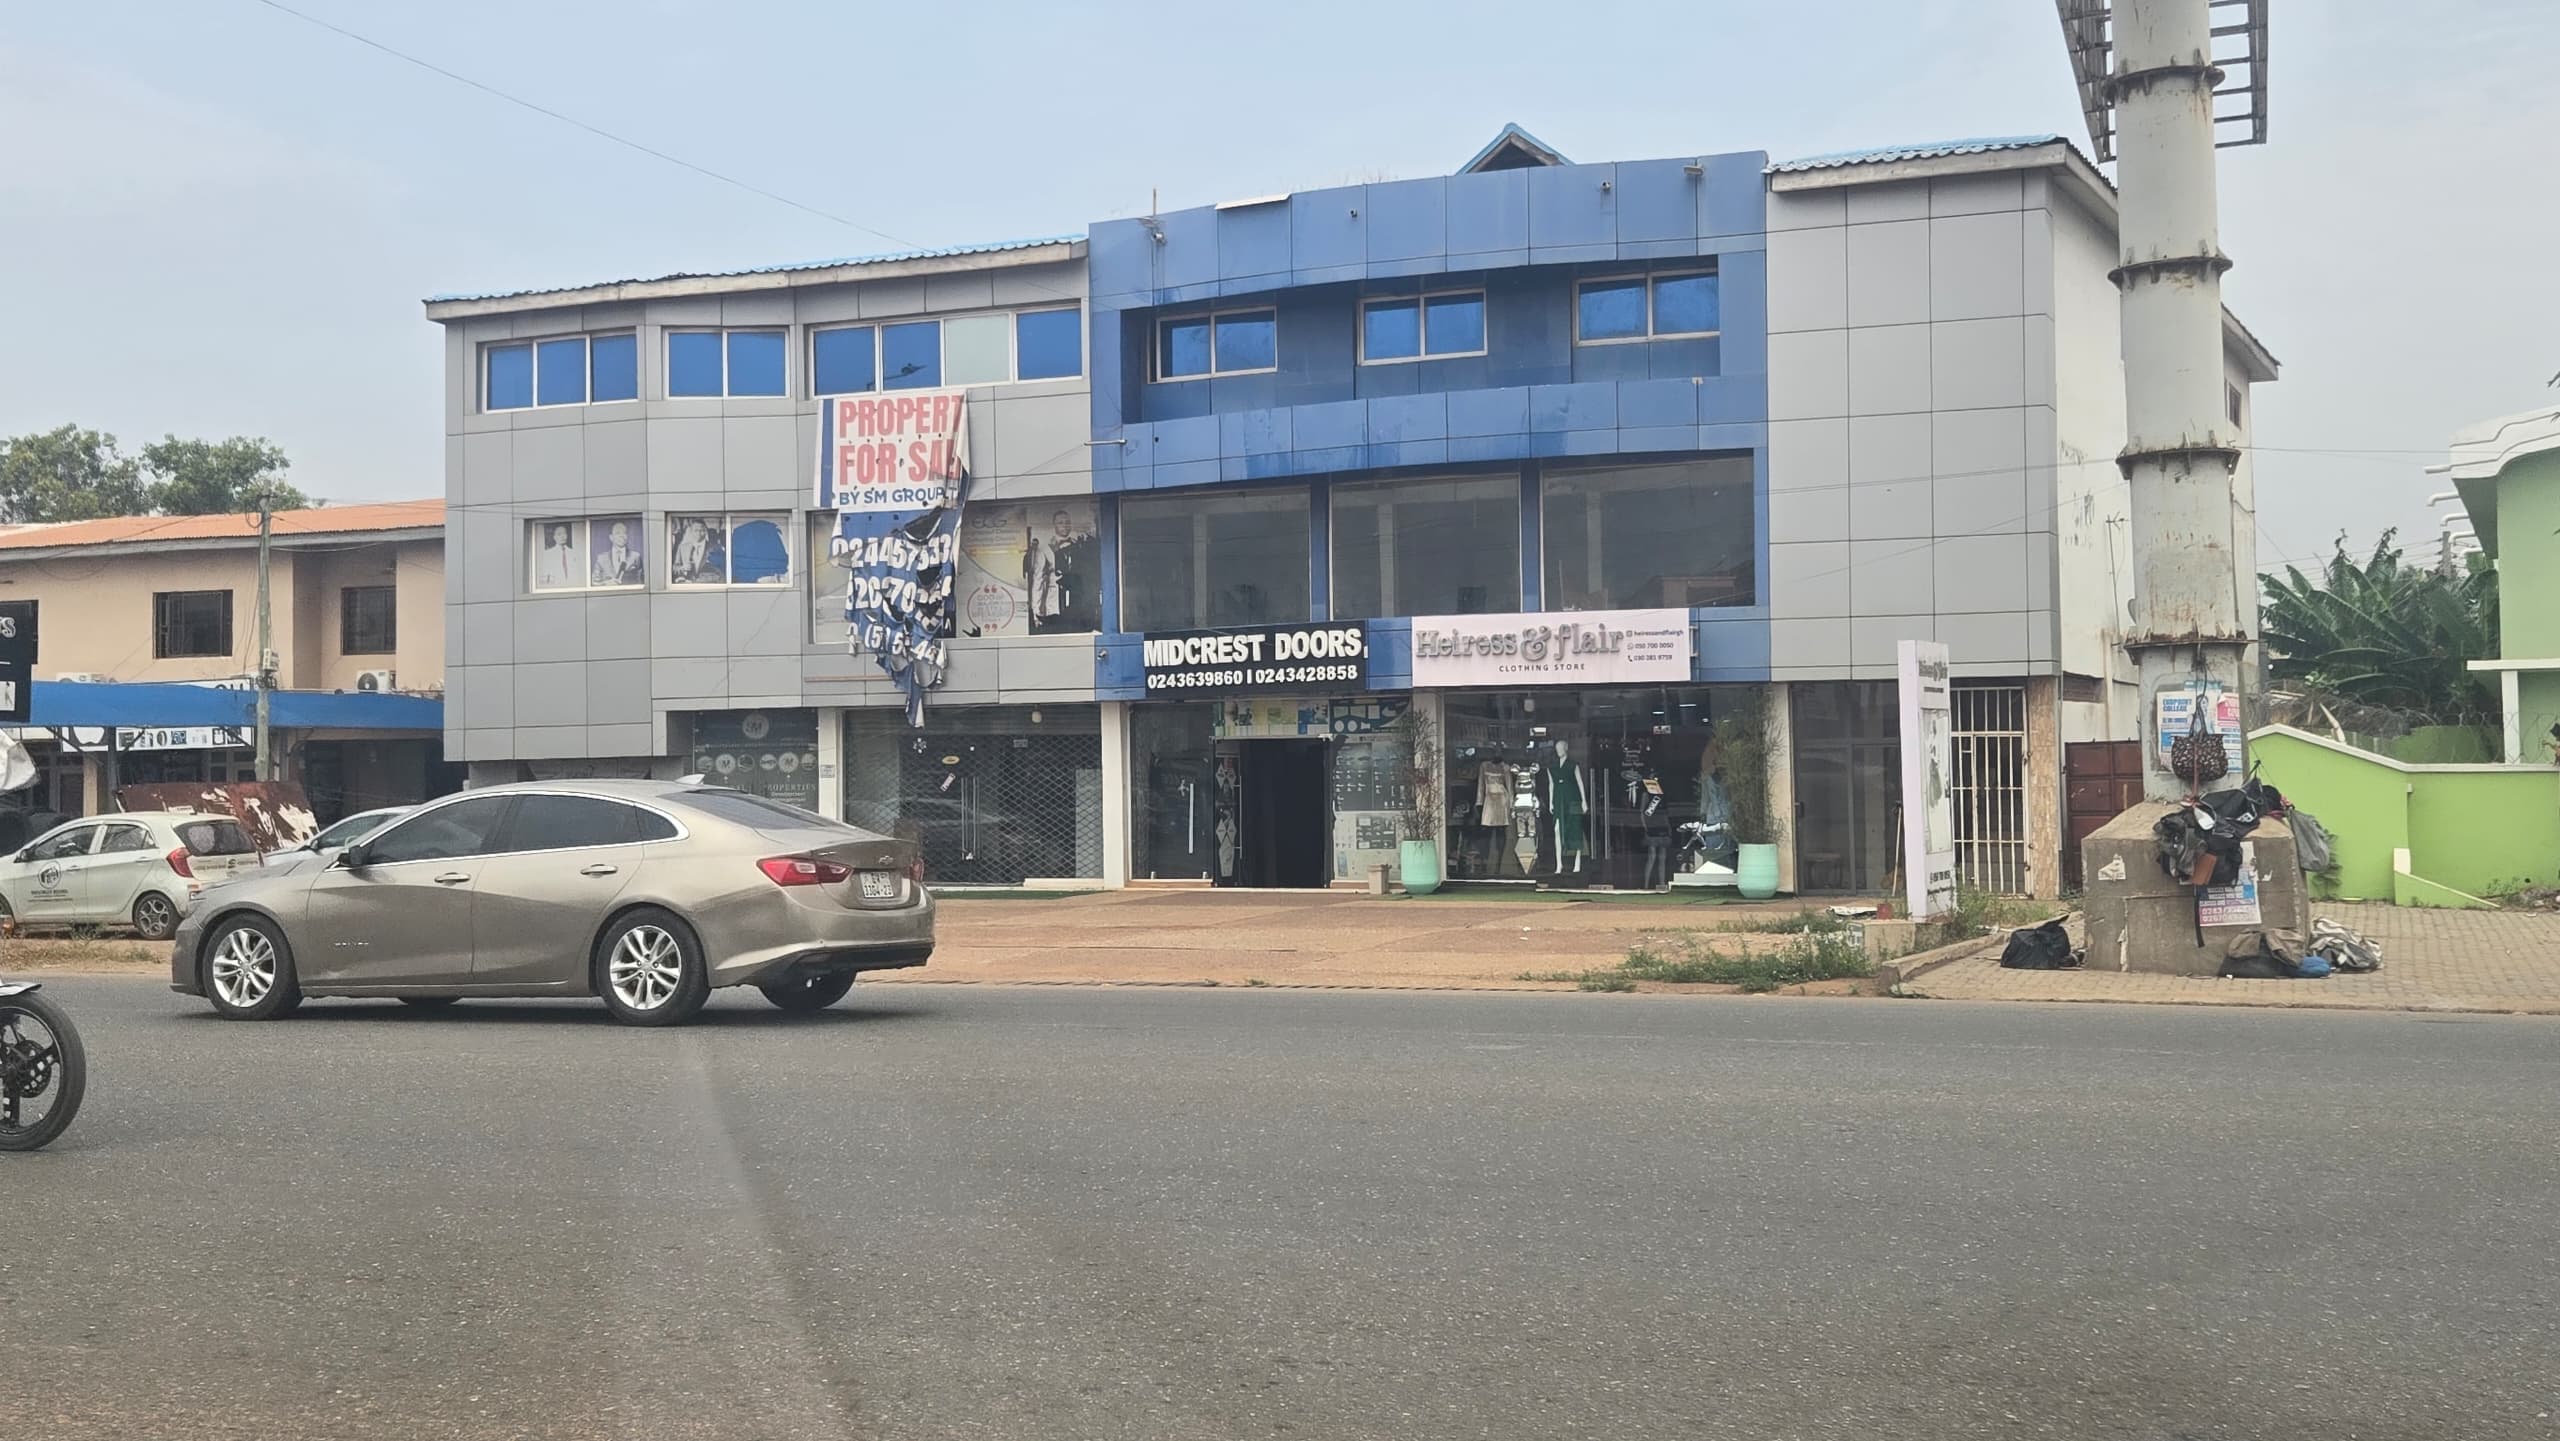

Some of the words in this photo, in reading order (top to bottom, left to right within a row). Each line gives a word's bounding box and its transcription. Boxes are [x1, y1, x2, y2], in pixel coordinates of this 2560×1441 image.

[839, 443, 897, 485] FOR
[839, 491, 860, 505] BY
[863, 489, 887, 503] SM
[892, 486, 945, 502] GROUP
[1143, 634, 1266, 667] MIDCREST
[1416, 628, 1517, 658] Heiress
[1520, 625, 1552, 661] &
[1554, 623, 1624, 660] flair
[1147, 671, 1243, 690] 0243639860
[1255, 665, 1358, 684] 0243428858
[1499, 664, 1549, 673] CLOTHING
[1554, 663, 1585, 671] STORE
